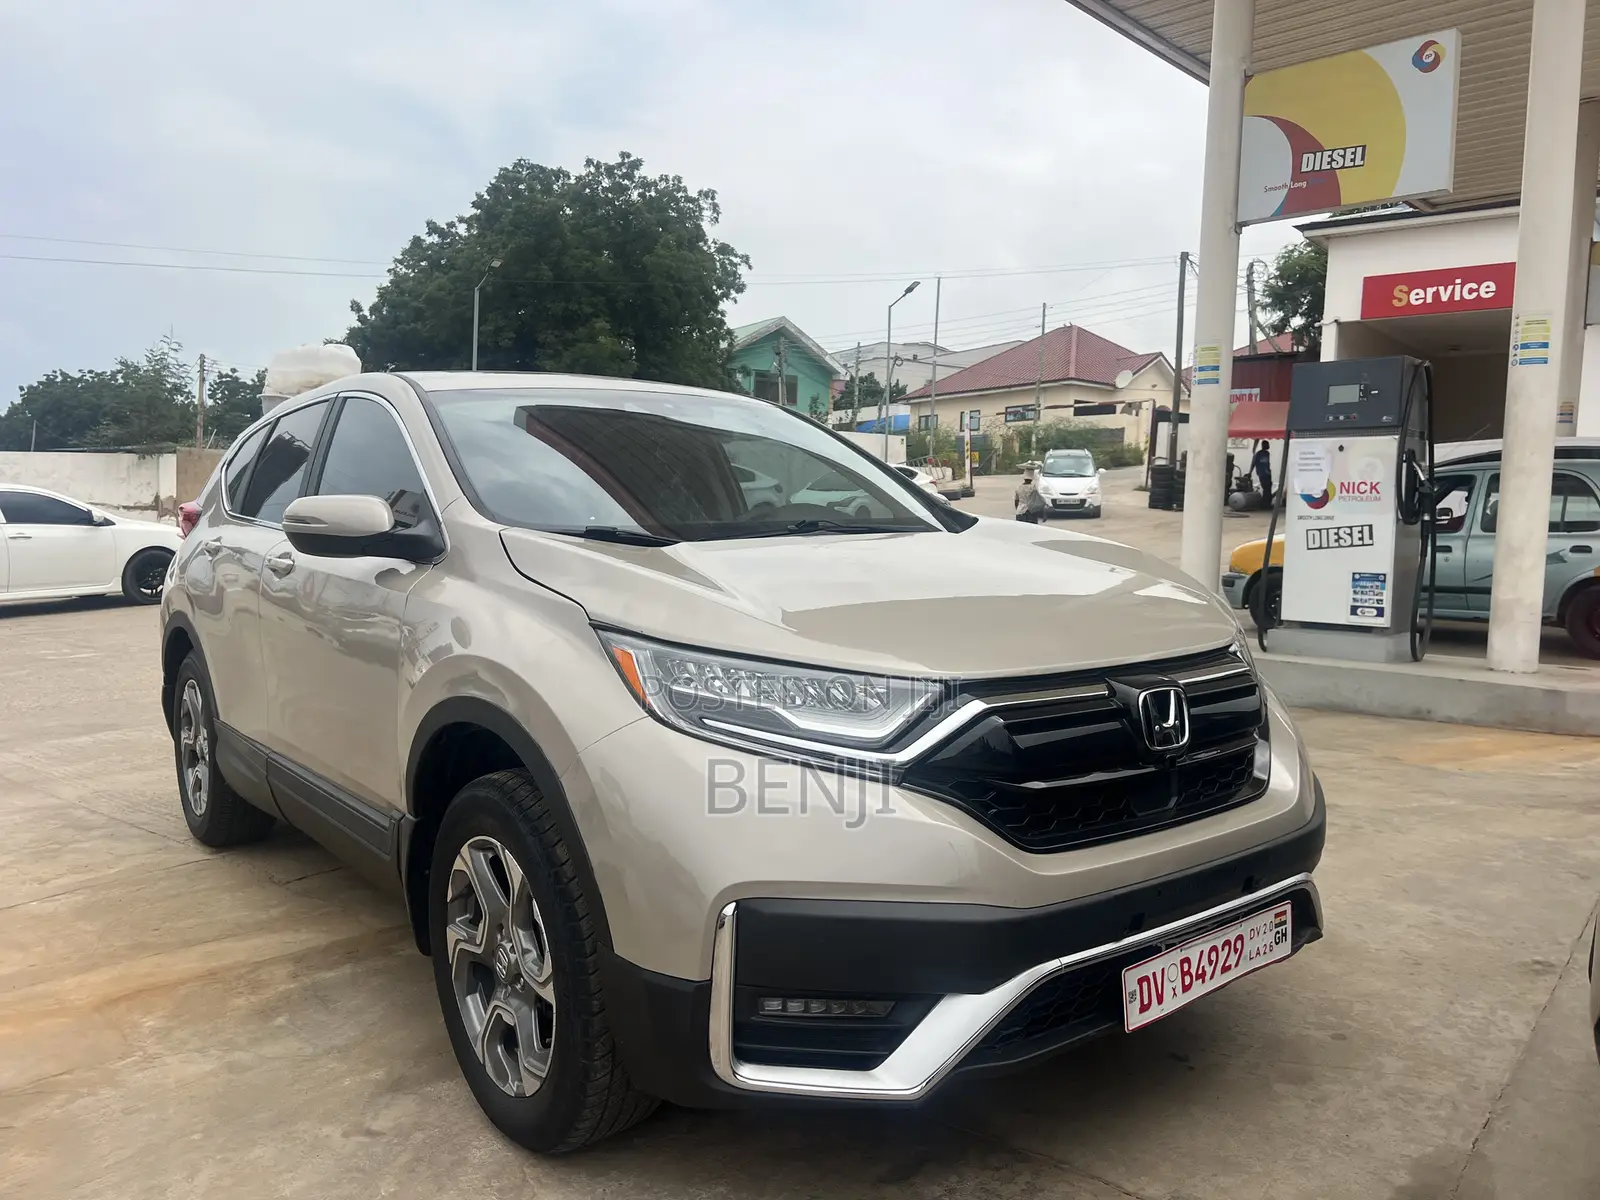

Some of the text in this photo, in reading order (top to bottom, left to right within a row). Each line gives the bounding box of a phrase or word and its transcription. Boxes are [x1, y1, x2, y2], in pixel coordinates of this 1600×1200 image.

[1300, 146, 1364, 172] DIESEL
[1264, 183, 1289, 193] Smooth
[1290, 181, 1307, 189] Long
[1392, 278, 1497, 307] Service
[1339, 481, 1381, 495] NICK
[1307, 525, 1373, 549] DIESEL
[1274, 926, 1287, 946] GH
[1137, 967, 1165, 1014] DV
[1179, 933, 1245, 994] B4929
